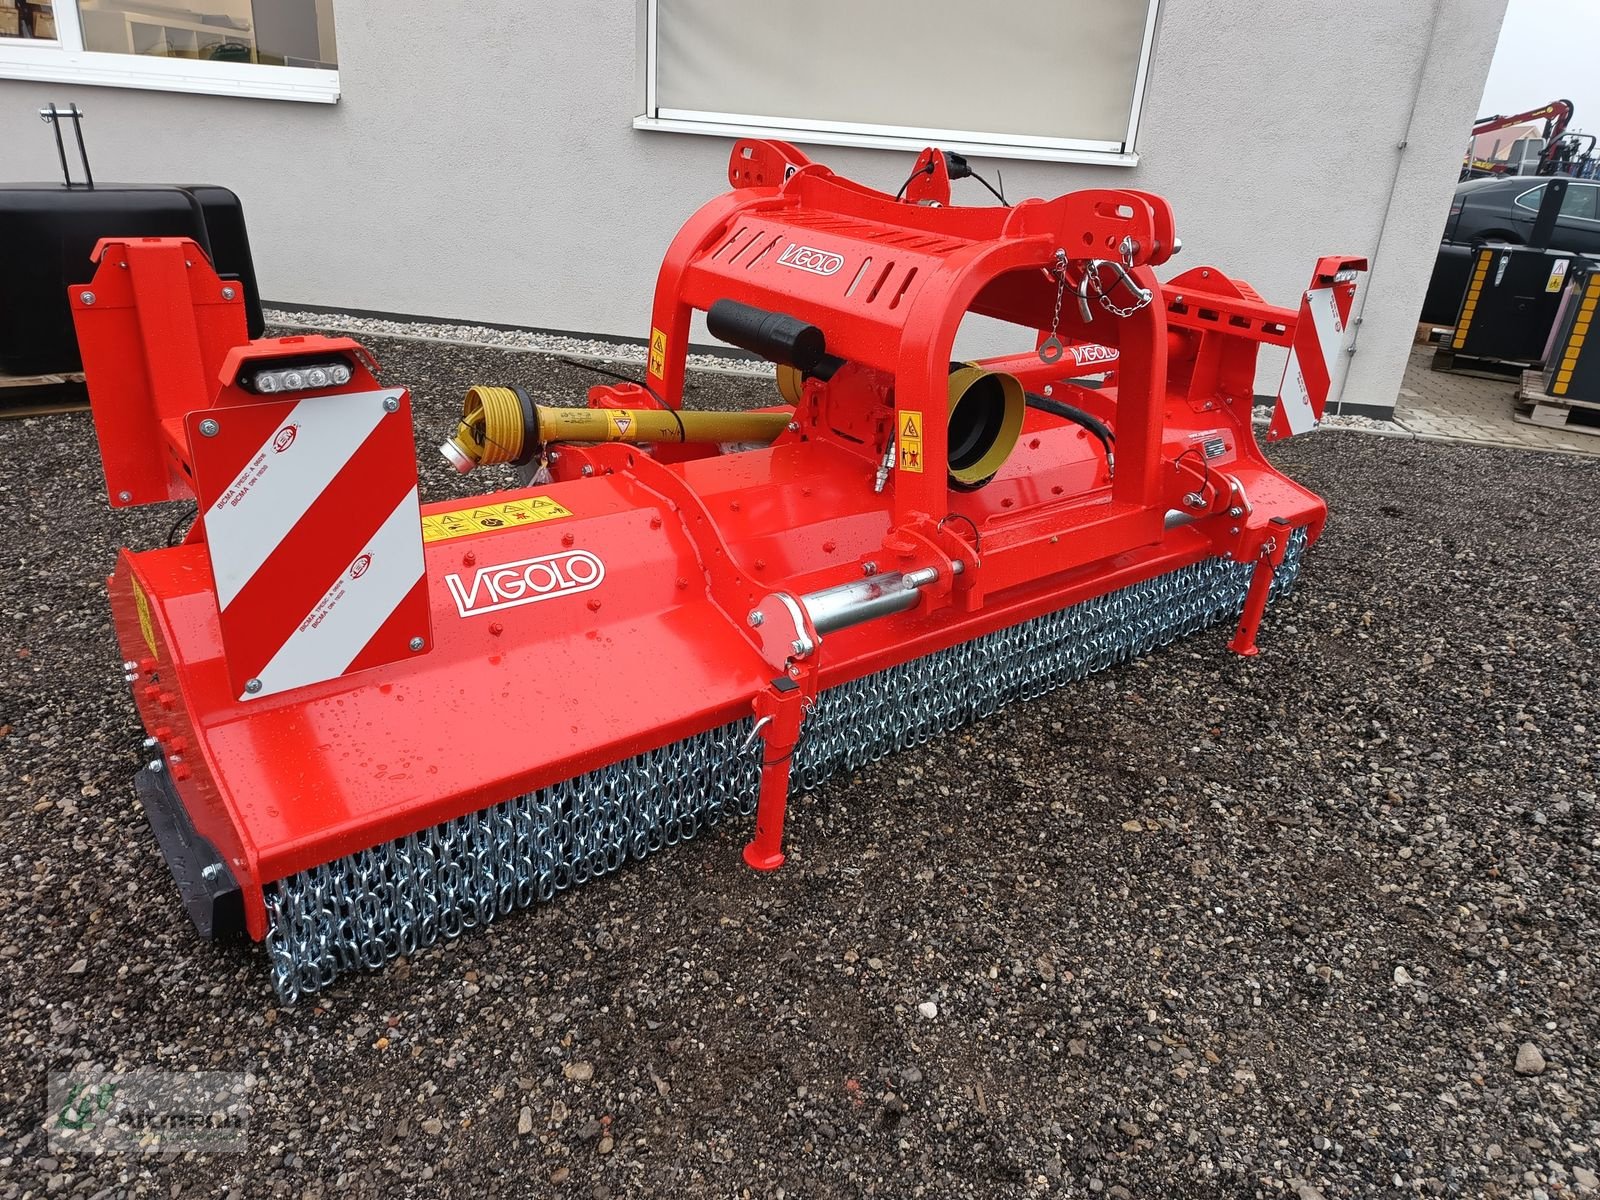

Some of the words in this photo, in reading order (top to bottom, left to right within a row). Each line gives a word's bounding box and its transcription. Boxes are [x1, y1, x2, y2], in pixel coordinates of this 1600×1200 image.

[777, 243, 845, 275] VIGOLO
[1069, 344, 1119, 366] VIGOLO
[217, 490, 235, 509] BICMA
[231, 487, 249, 507] BICMA
[445, 551, 604, 616] VIGOLO
[299, 614, 316, 632] BICMA
[312, 611, 328, 628] BICMA
